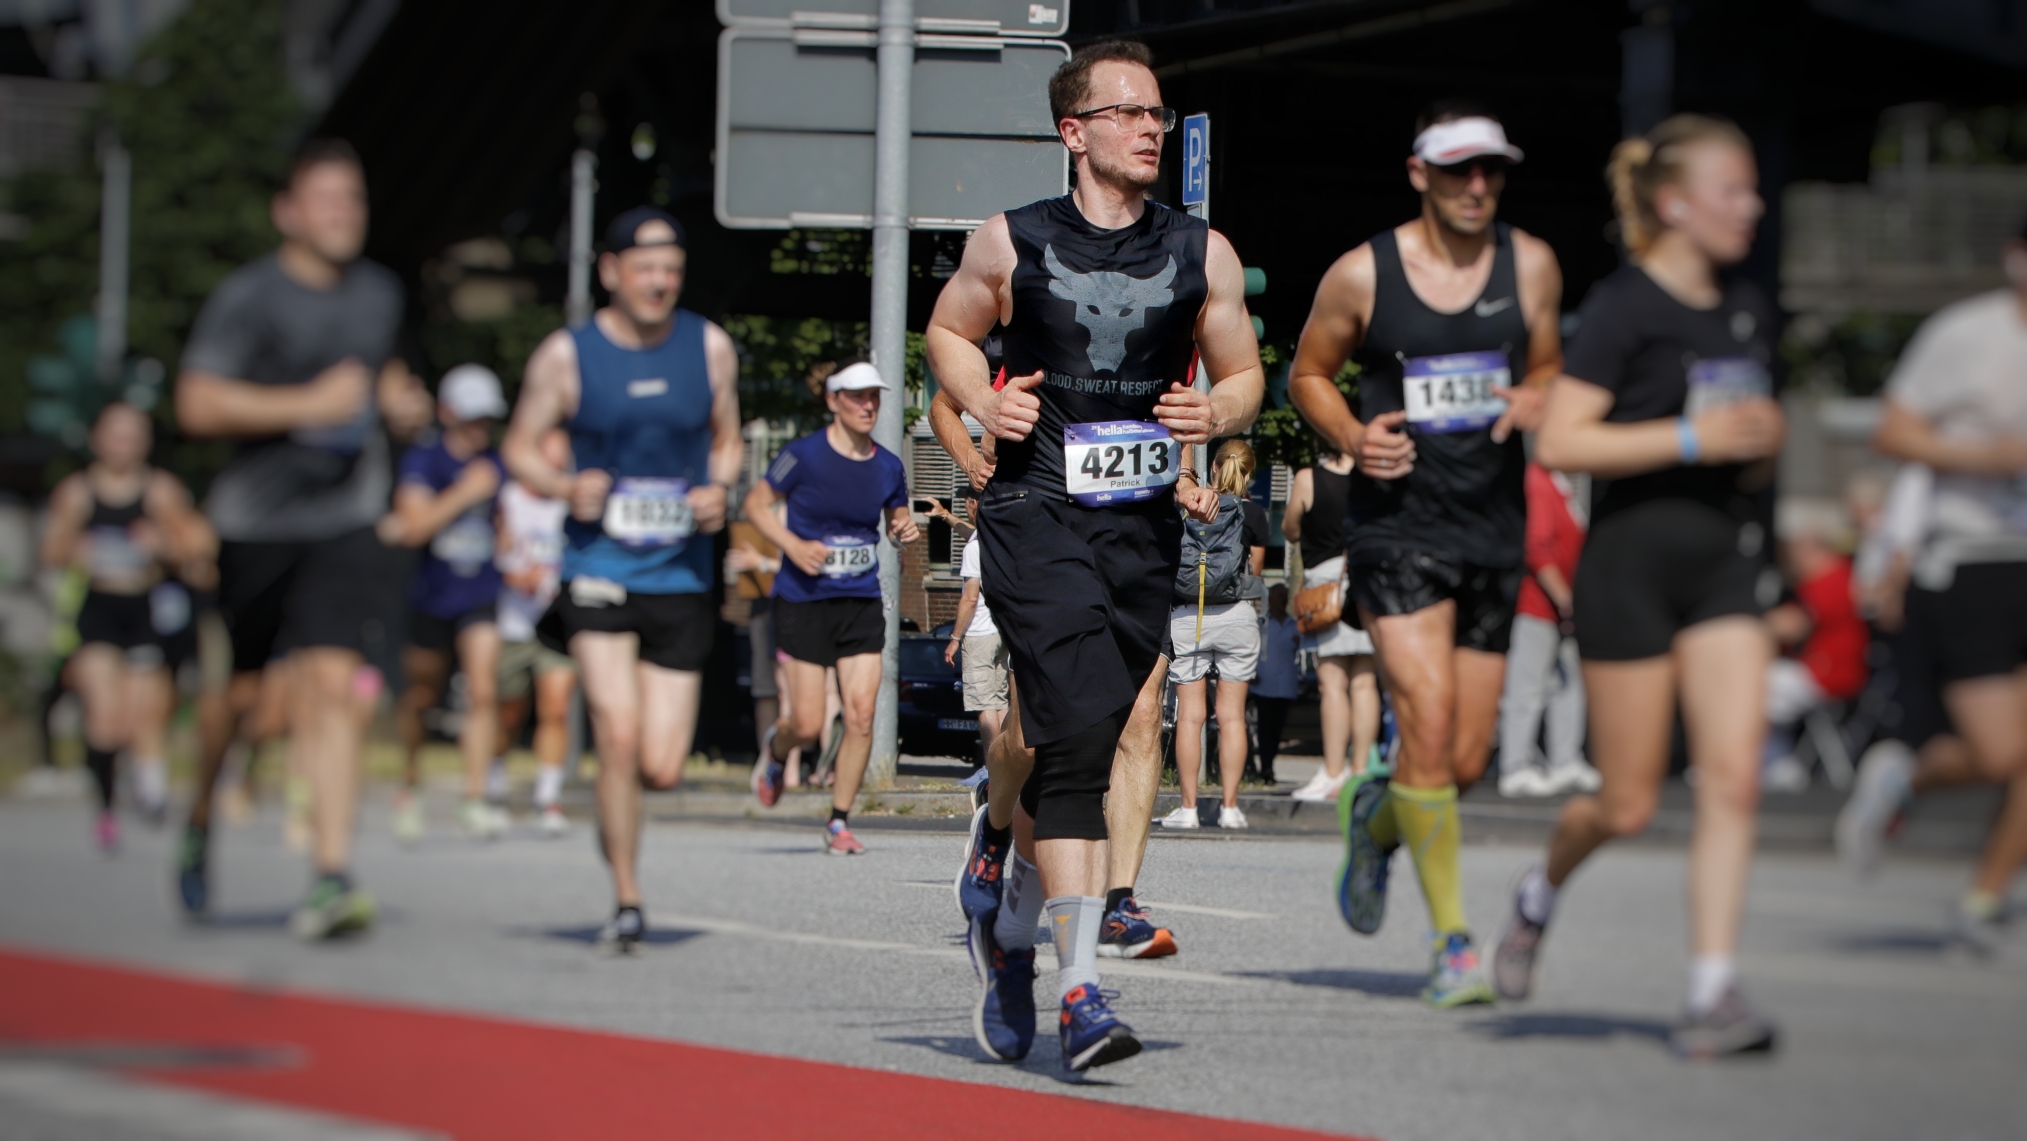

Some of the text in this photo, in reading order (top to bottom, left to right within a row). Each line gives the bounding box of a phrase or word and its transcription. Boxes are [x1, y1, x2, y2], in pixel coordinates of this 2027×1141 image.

[1189, 128, 1201, 192] P
[1097, 424, 1123, 436] hella
[1081, 442, 1169, 479] 4213
[1110, 479, 1141, 488] Patrick
